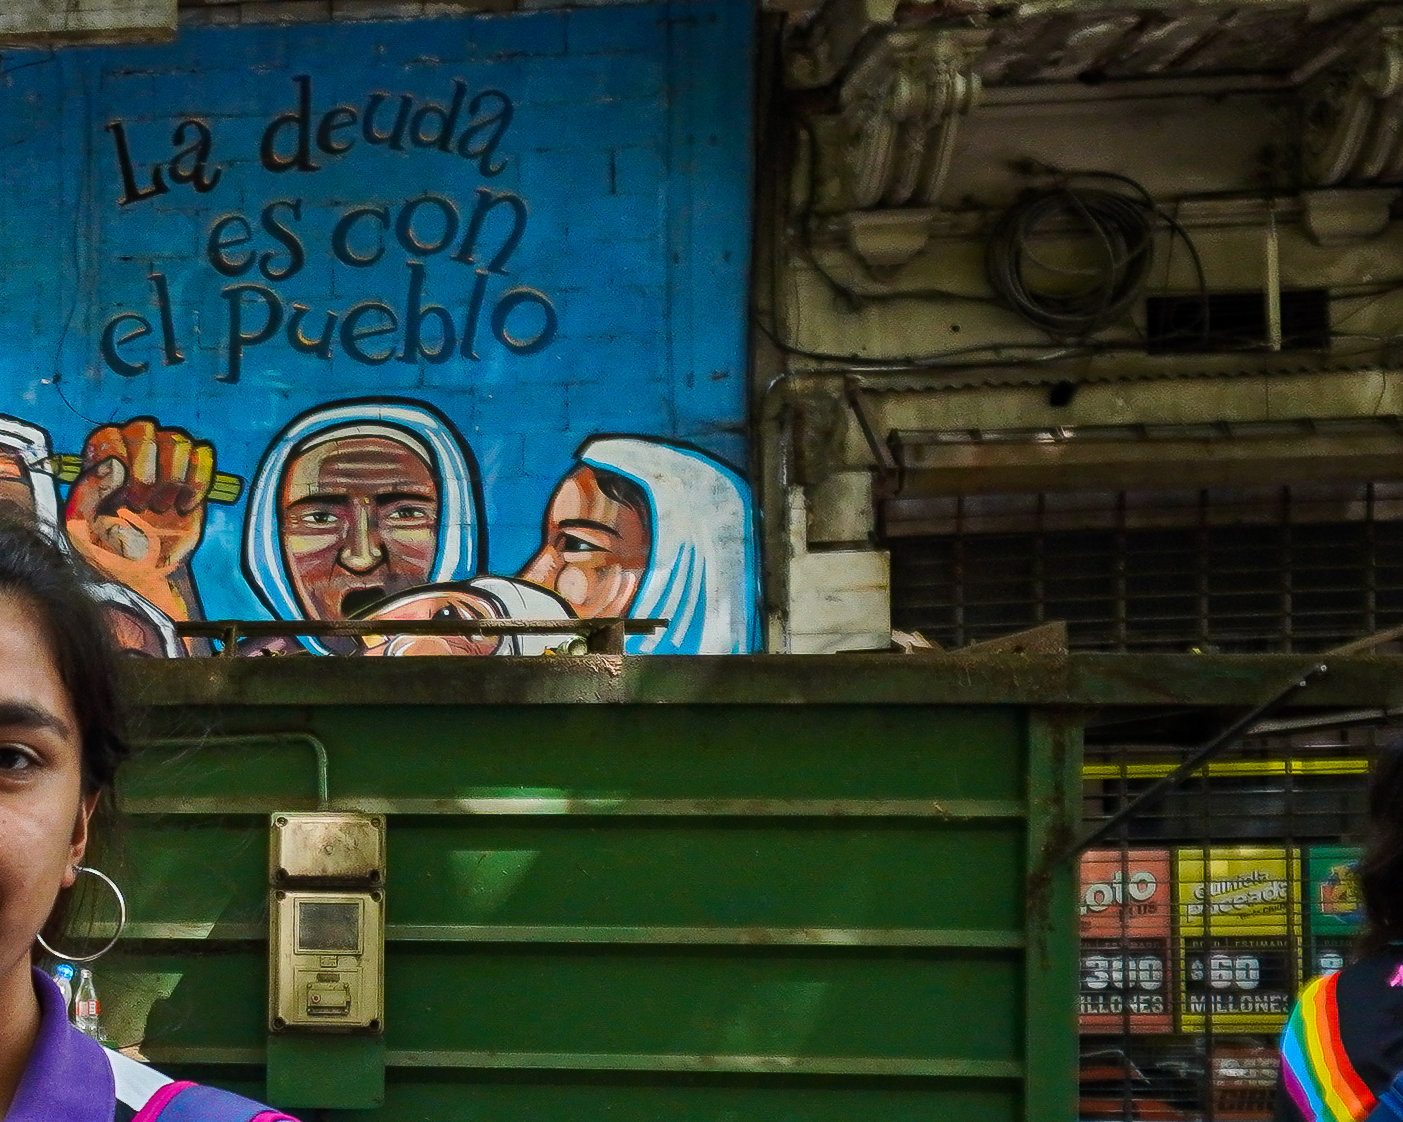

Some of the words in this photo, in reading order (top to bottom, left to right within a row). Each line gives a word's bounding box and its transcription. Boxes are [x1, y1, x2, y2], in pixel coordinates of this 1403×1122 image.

[106, 118, 223, 206] La
[260, 74, 514, 179] deuda
[207, 199, 306, 282] es
[330, 187, 530, 276] con
[100, 271, 186, 378] el
[1081, 870, 1157, 916] oto
